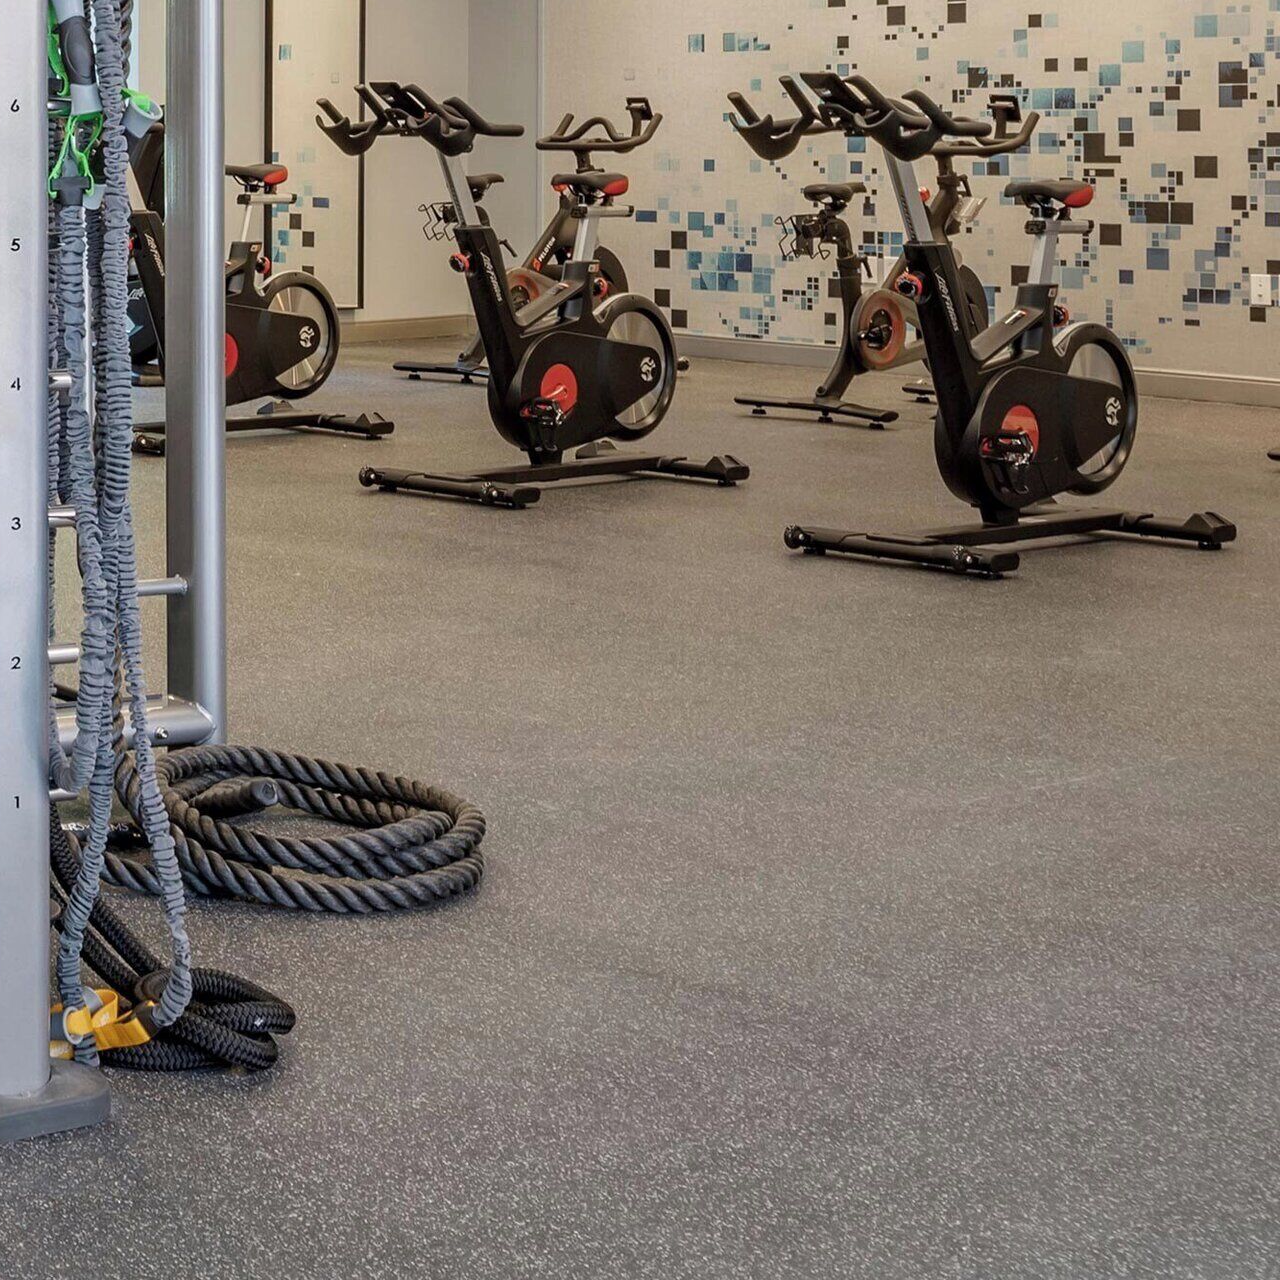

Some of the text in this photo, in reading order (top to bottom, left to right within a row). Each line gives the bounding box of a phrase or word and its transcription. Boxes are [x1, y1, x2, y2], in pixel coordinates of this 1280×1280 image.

[10, 98, 20, 113] 6
[10, 237, 21, 252] 5
[10, 377, 22, 391] 4
[10, 516, 22, 531] 3
[10, 656, 21, 670] 2
[13, 795, 20, 809] 1
